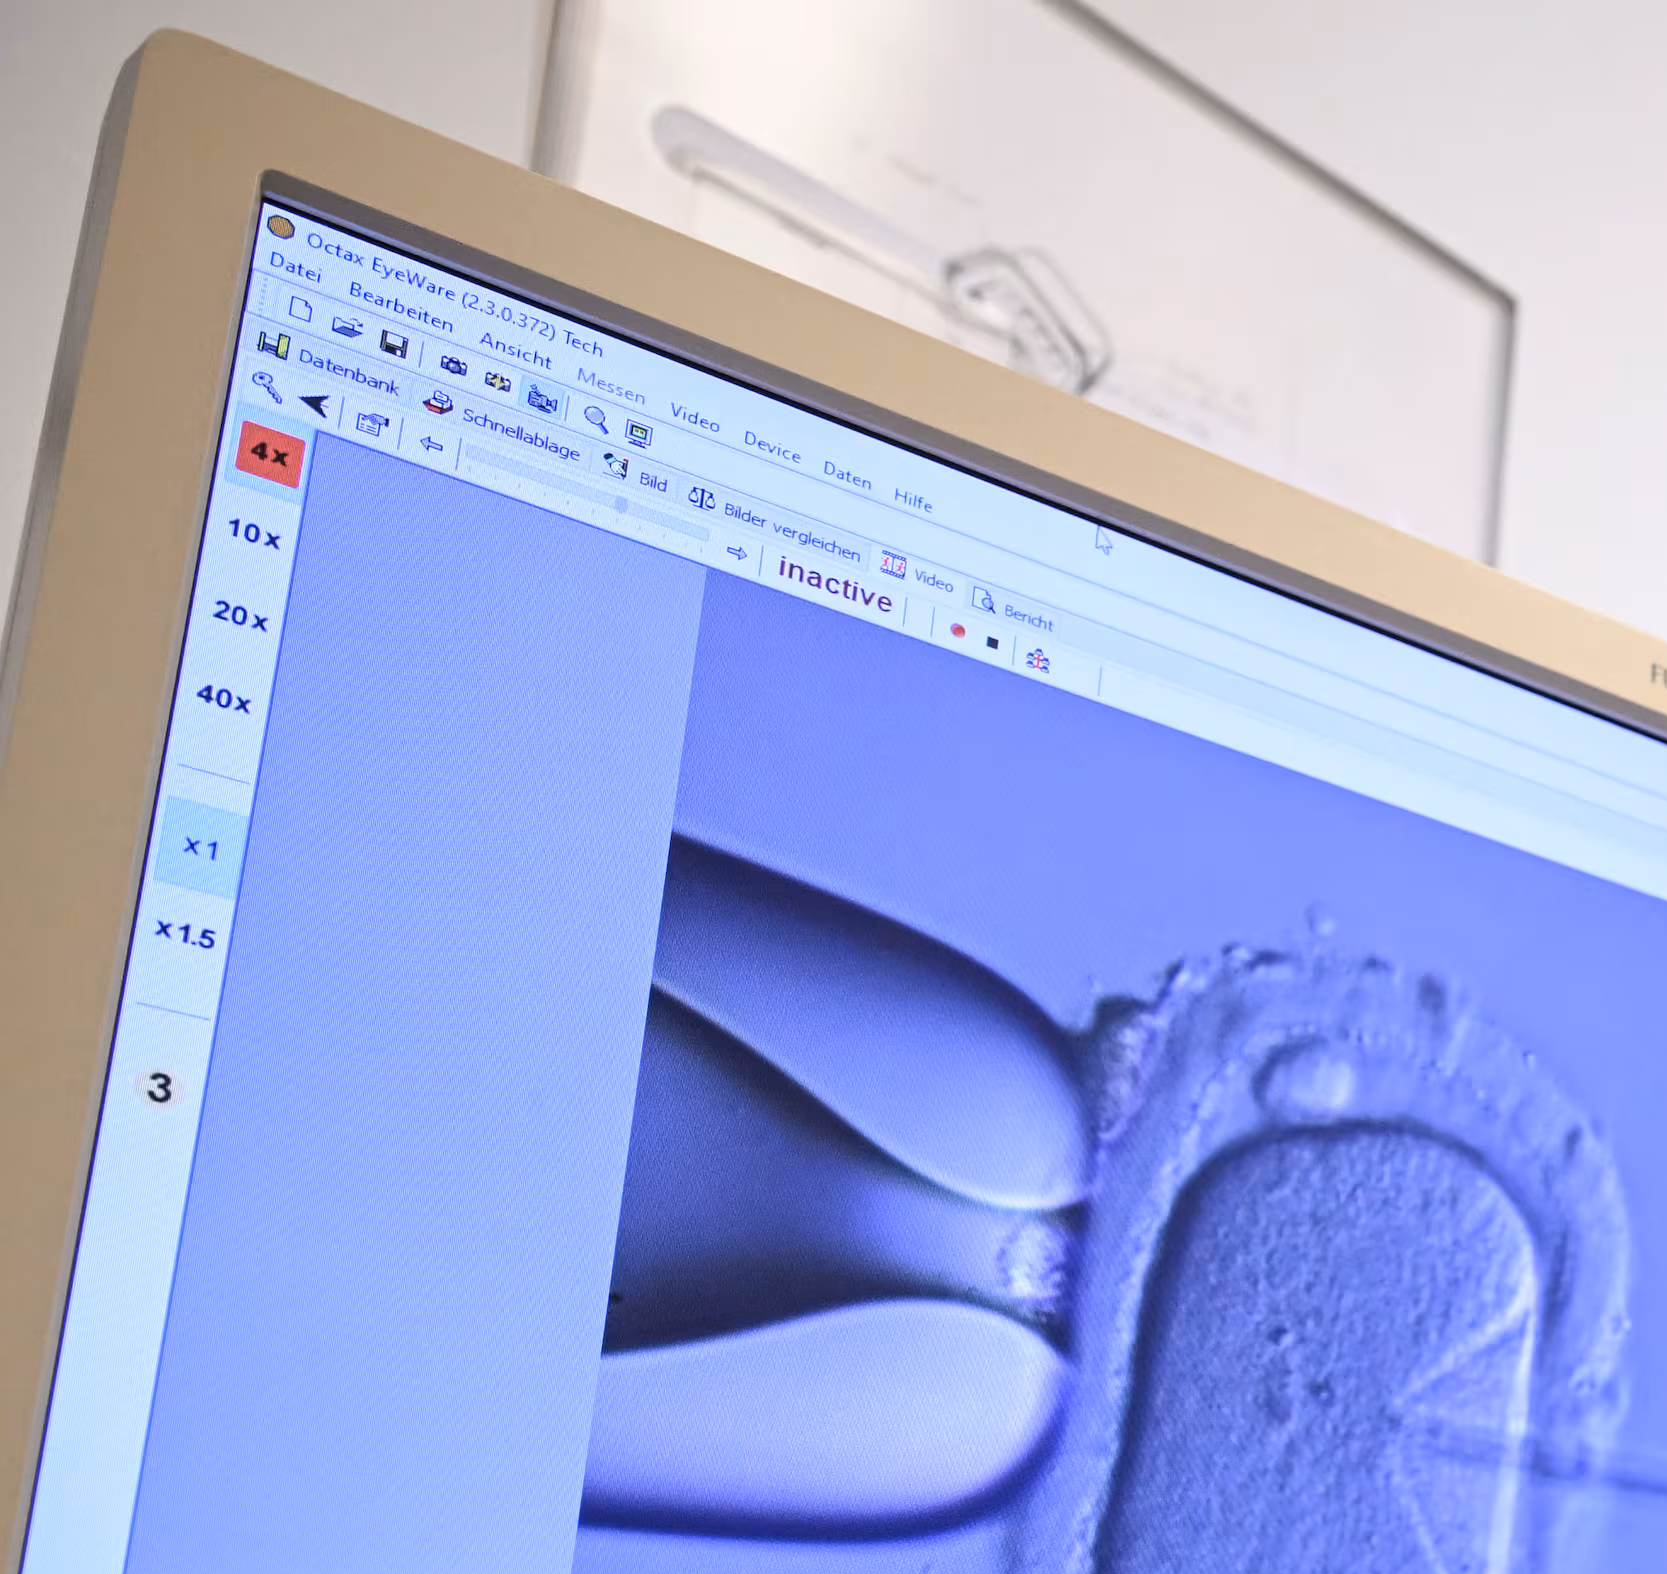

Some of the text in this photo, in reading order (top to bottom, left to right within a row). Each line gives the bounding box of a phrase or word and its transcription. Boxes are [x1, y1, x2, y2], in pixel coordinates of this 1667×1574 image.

[307, 233, 604, 358] Octax EyeWare (2.3.0.372) Tech
[270, 251, 934, 514] Datei Bearbeiten Ansicht Messen Video Device Daten Hilfe
[299, 348, 1055, 634] Datenbank Schnellablage Bild Bilder vergleichen Video Bericht
[228, 517, 282, 550] 10x
[779, 556, 894, 613] inactive
[213, 599, 269, 633] 20x
[196, 684, 252, 714] 40x
[147, 1072, 173, 1104] 3
